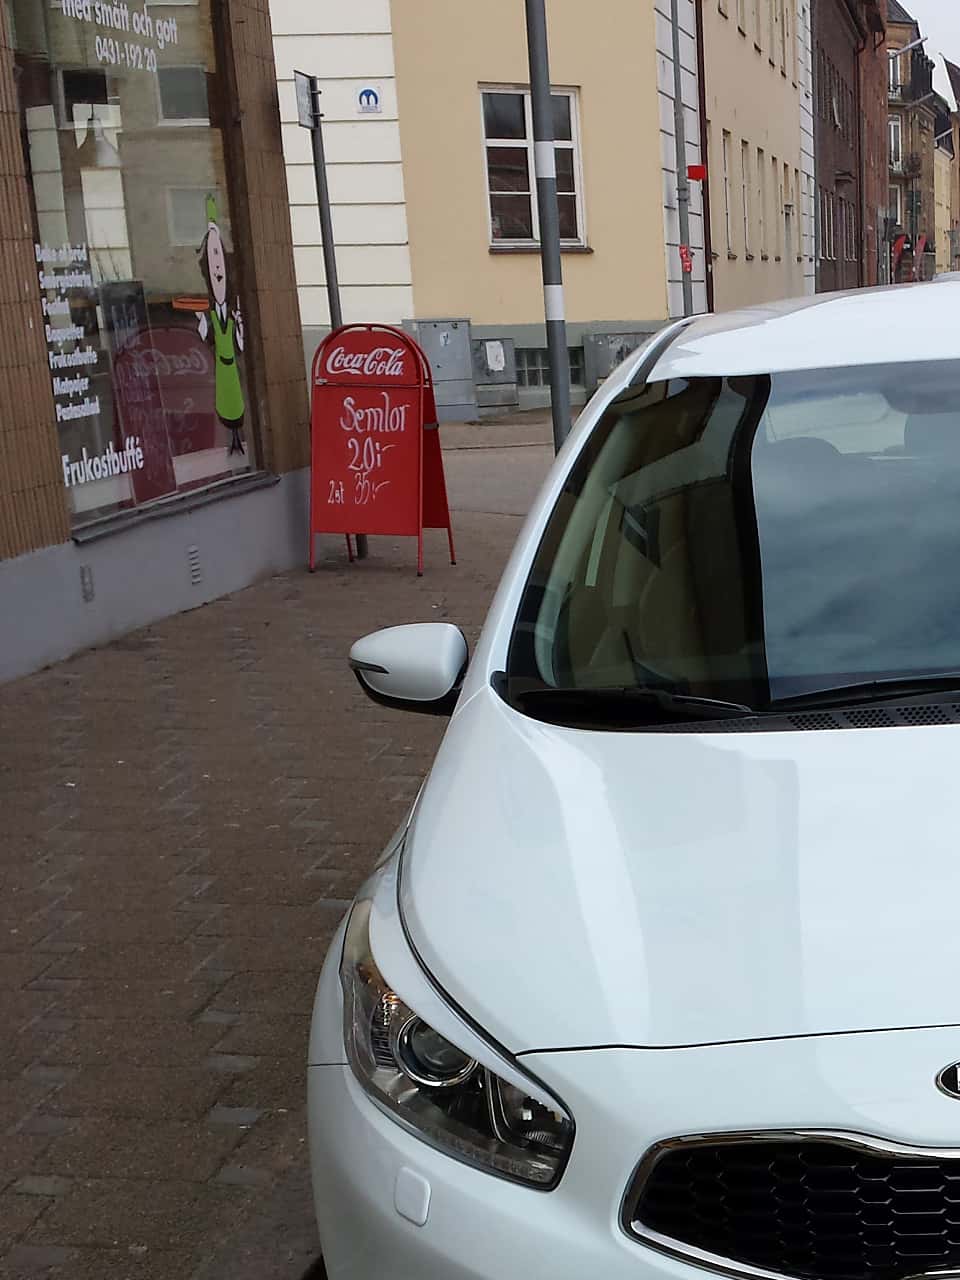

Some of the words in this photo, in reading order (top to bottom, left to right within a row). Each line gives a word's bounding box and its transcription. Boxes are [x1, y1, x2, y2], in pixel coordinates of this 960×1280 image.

[61, 0, 91, 21] med
[95, 0, 129, 32] smått
[132, 2, 153, 38] och
[156, 16, 177, 50] gott
[326, 347, 405, 375] Coca-Cola
[340, 392, 410, 432] Semlor
[62, 436, 144, 487] Frukostbuffé
